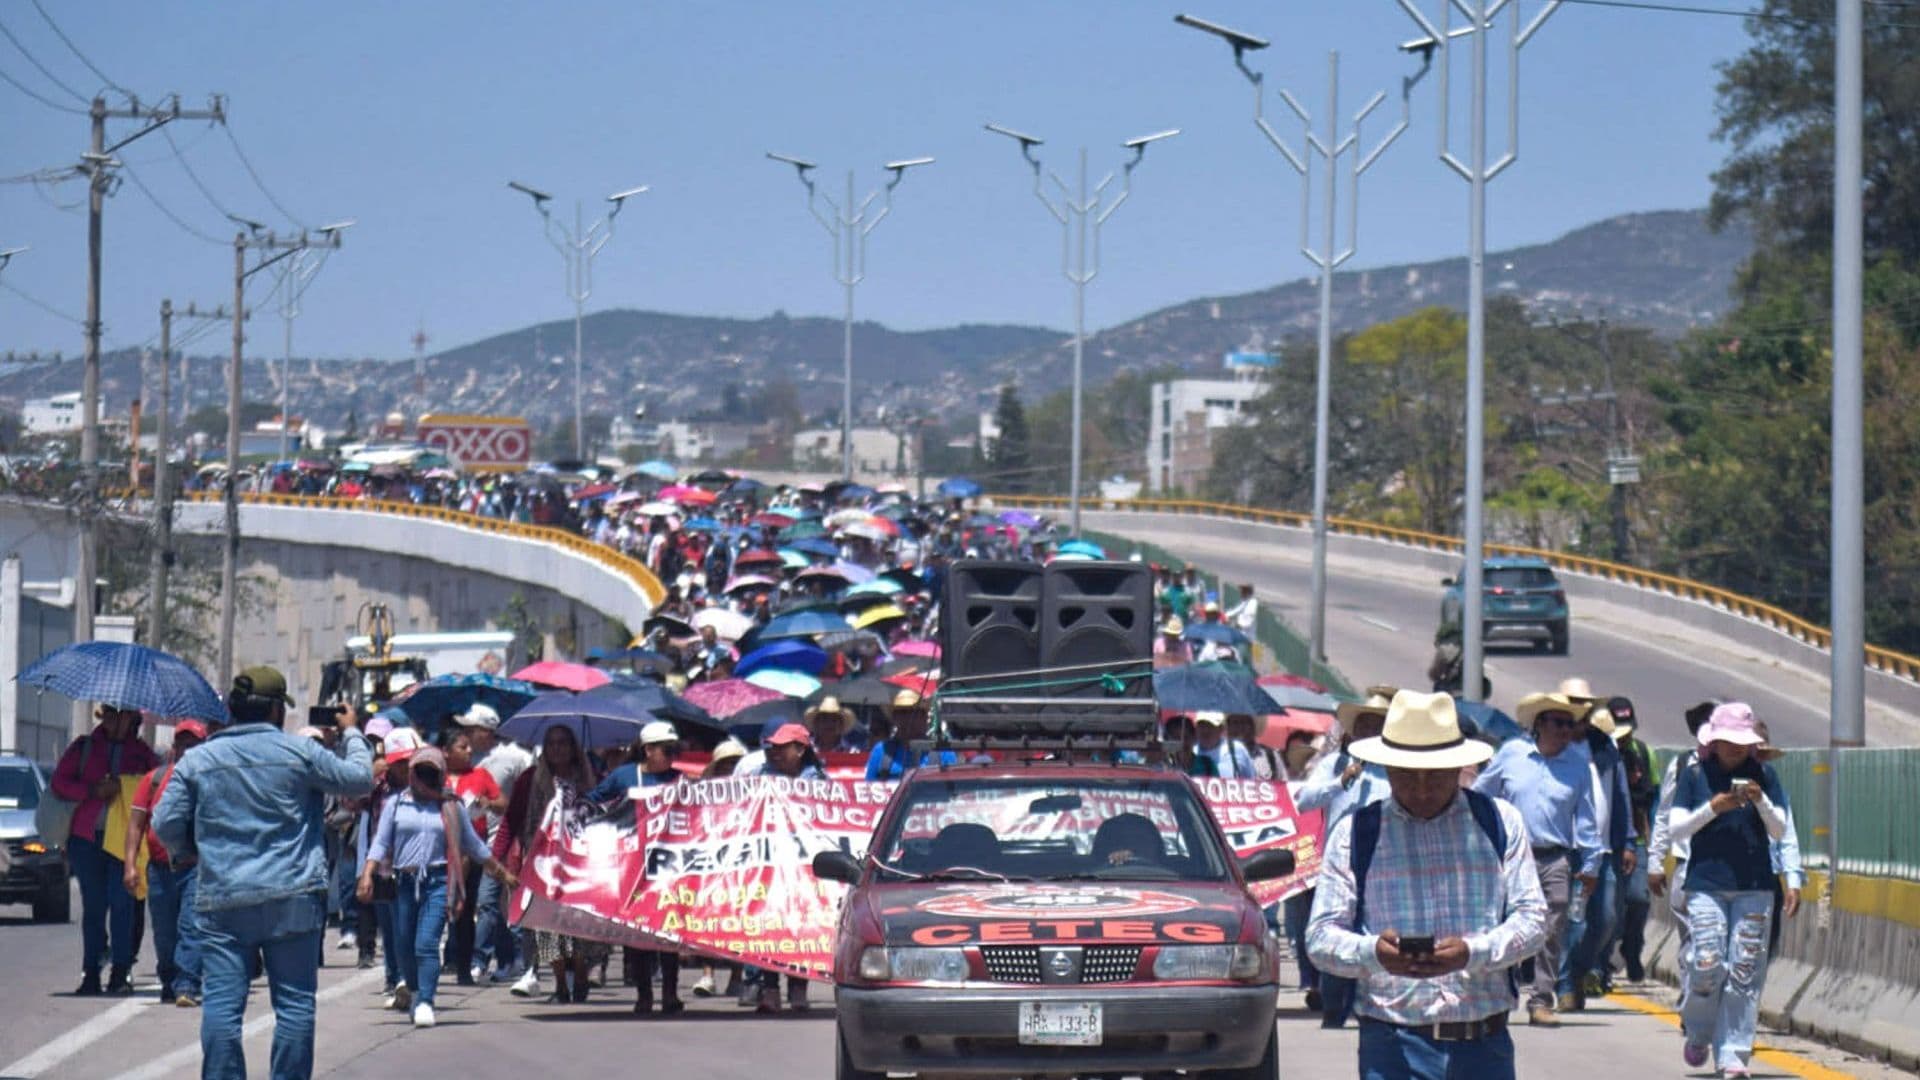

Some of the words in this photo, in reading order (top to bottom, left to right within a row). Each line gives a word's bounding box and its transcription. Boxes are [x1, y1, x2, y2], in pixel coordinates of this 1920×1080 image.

[426, 429, 526, 460] OXXO
[645, 775, 847, 813] COORDINADORA
[646, 810, 690, 837] DE
[911, 921, 1225, 945] CETEG
